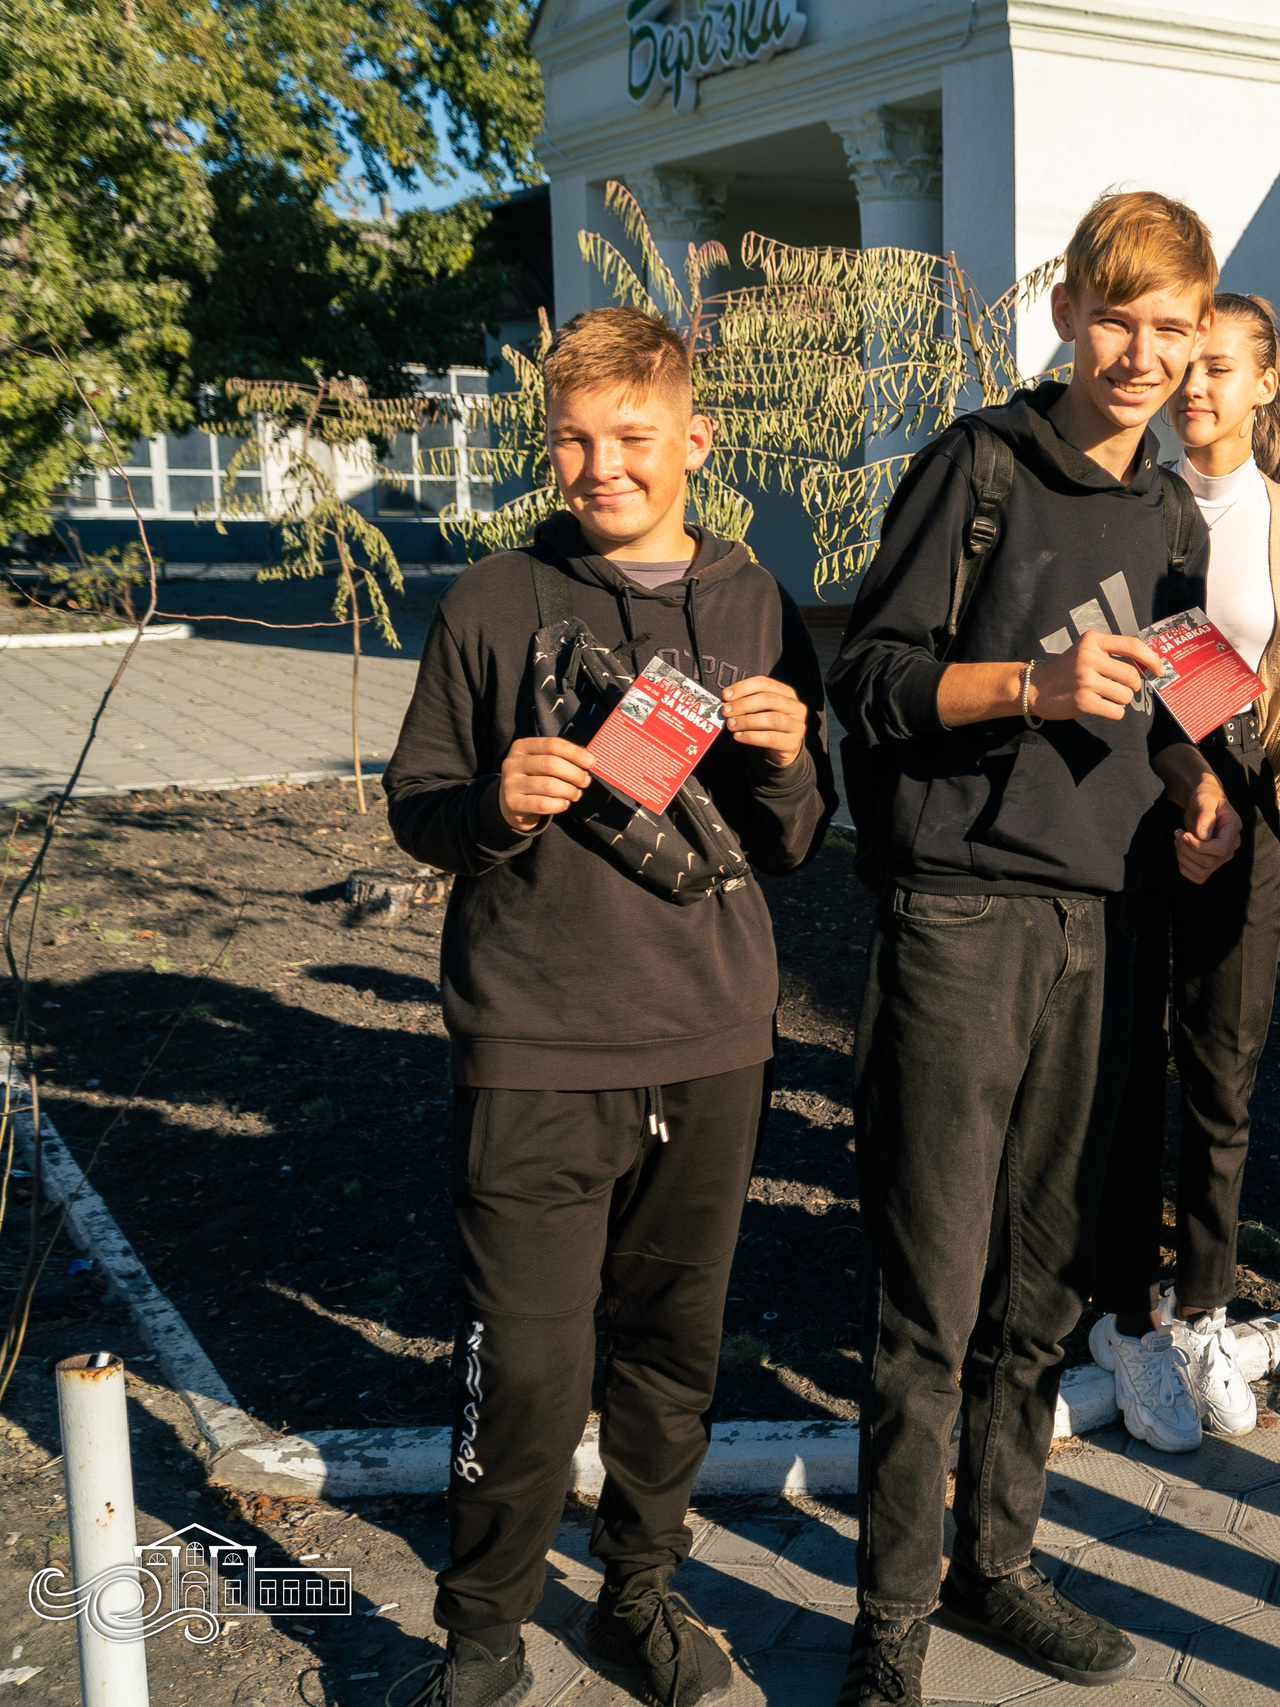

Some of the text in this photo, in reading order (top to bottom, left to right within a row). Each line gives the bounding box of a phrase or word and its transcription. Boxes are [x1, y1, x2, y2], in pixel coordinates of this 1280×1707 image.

[627, 0, 793, 111] Березка
[1174, 624, 1212, 646] КАВКАЗ
[1160, 643, 1175, 654] ЗА
[656, 678, 702, 715] БИТВА
[661, 694, 676, 709] ЗА
[675, 703, 714, 733] КАВКАЗ
